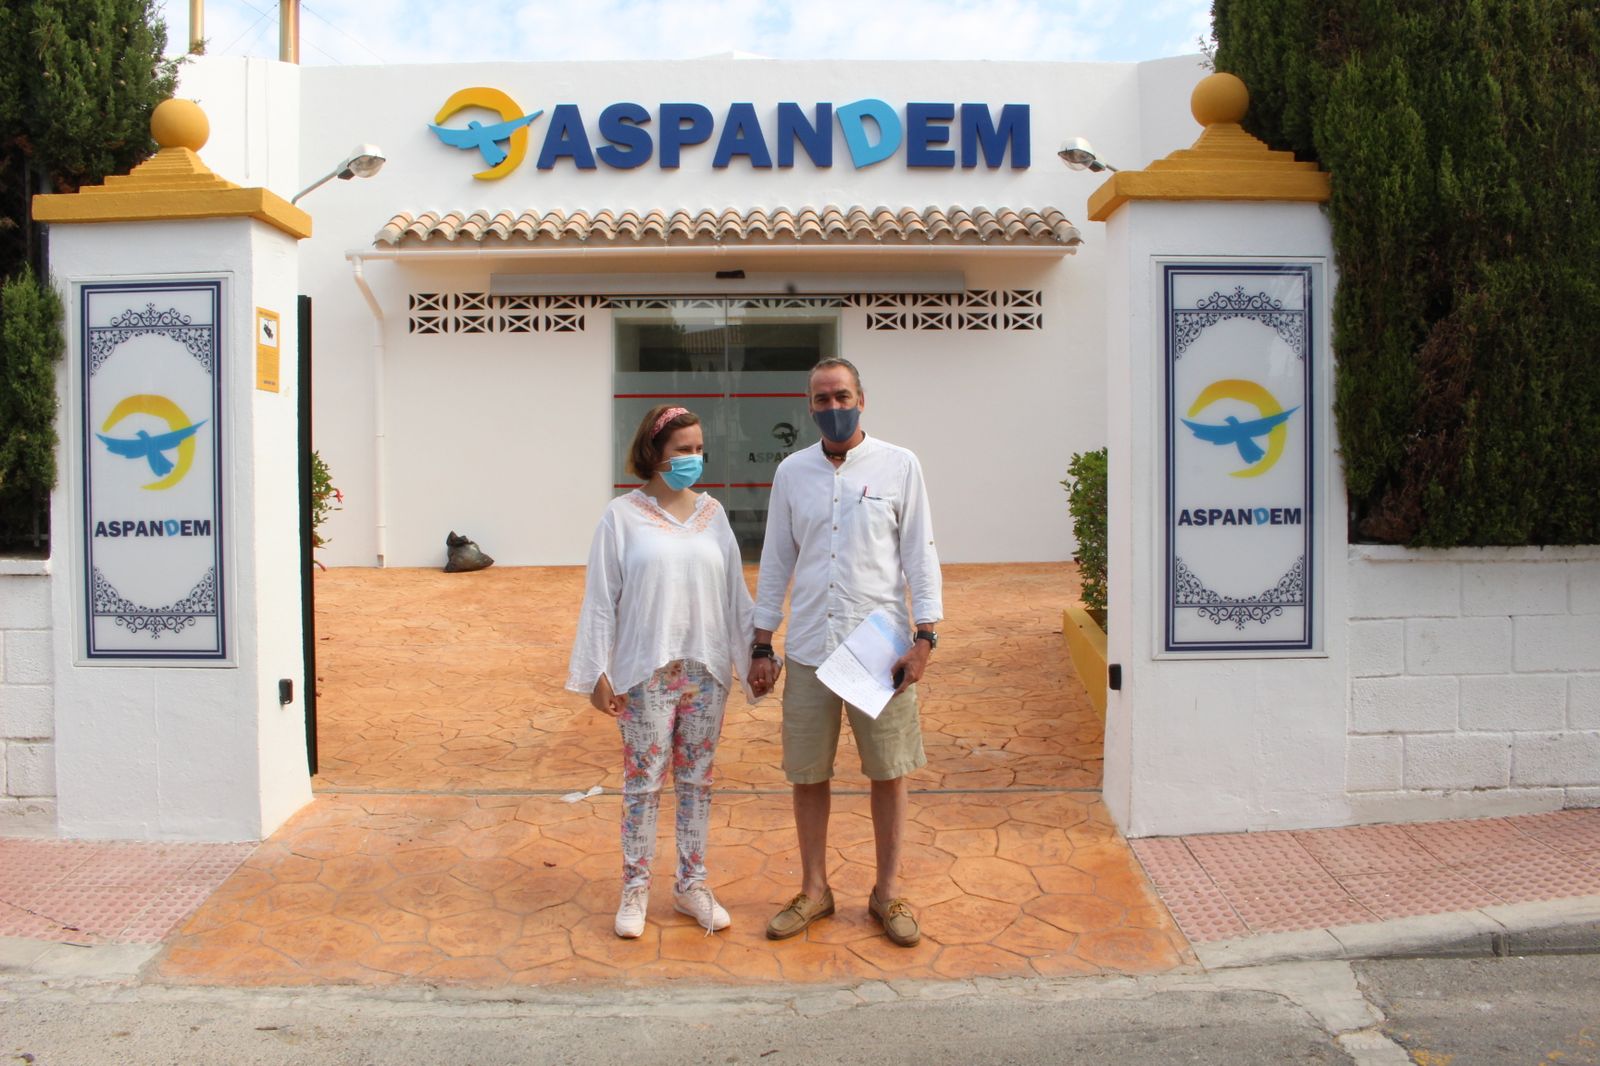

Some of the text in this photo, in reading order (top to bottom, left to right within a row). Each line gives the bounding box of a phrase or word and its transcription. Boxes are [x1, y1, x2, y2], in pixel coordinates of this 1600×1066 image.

[537, 98, 1030, 169] ASPANDEM
[1178, 507, 1301, 526] ASPANDEM
[94, 519, 211, 537] ASPANDEM
